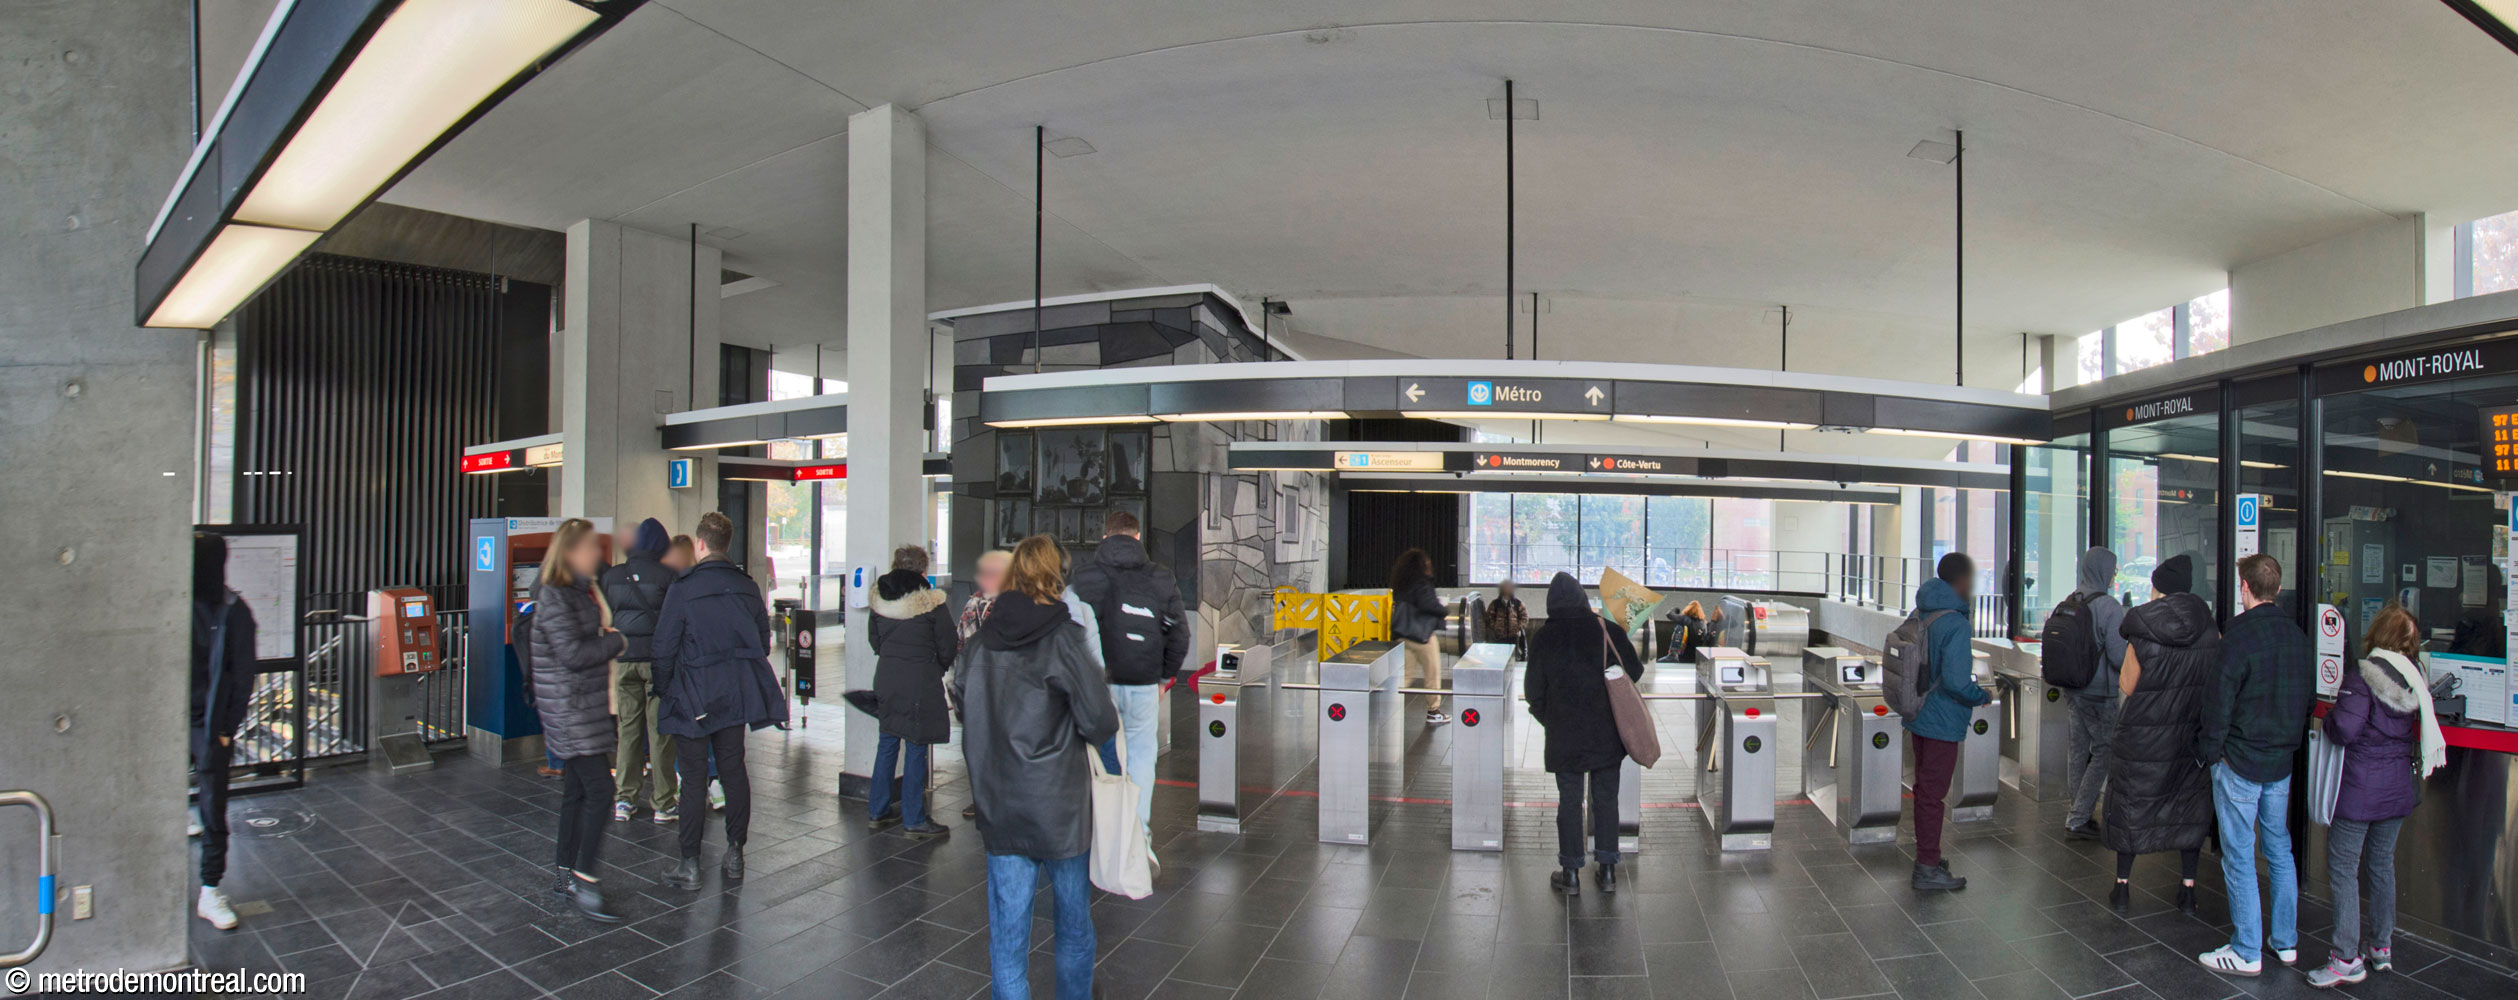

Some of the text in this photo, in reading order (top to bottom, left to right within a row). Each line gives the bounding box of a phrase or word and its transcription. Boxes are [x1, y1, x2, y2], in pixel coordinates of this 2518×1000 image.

[2379, 349, 2484, 382] MONT-ROYAL
[1495, 386, 1542, 402] Métro
[2134, 396, 2194, 420] MONT-ROYAL
[2492, 414, 2508, 426] 97
[2494, 429, 2508, 441] 11
[2494, 444, 2510, 456] 97
[478, 457, 493, 466] SORTIE
[1371, 457, 1412, 466] Ascenseur
[1503, 457, 1560, 469] Montmorency
[1617, 458, 1661, 470] Côte-Vertu
[2496, 458, 2511, 471] 11
[816, 468, 834, 476] SORTIE
